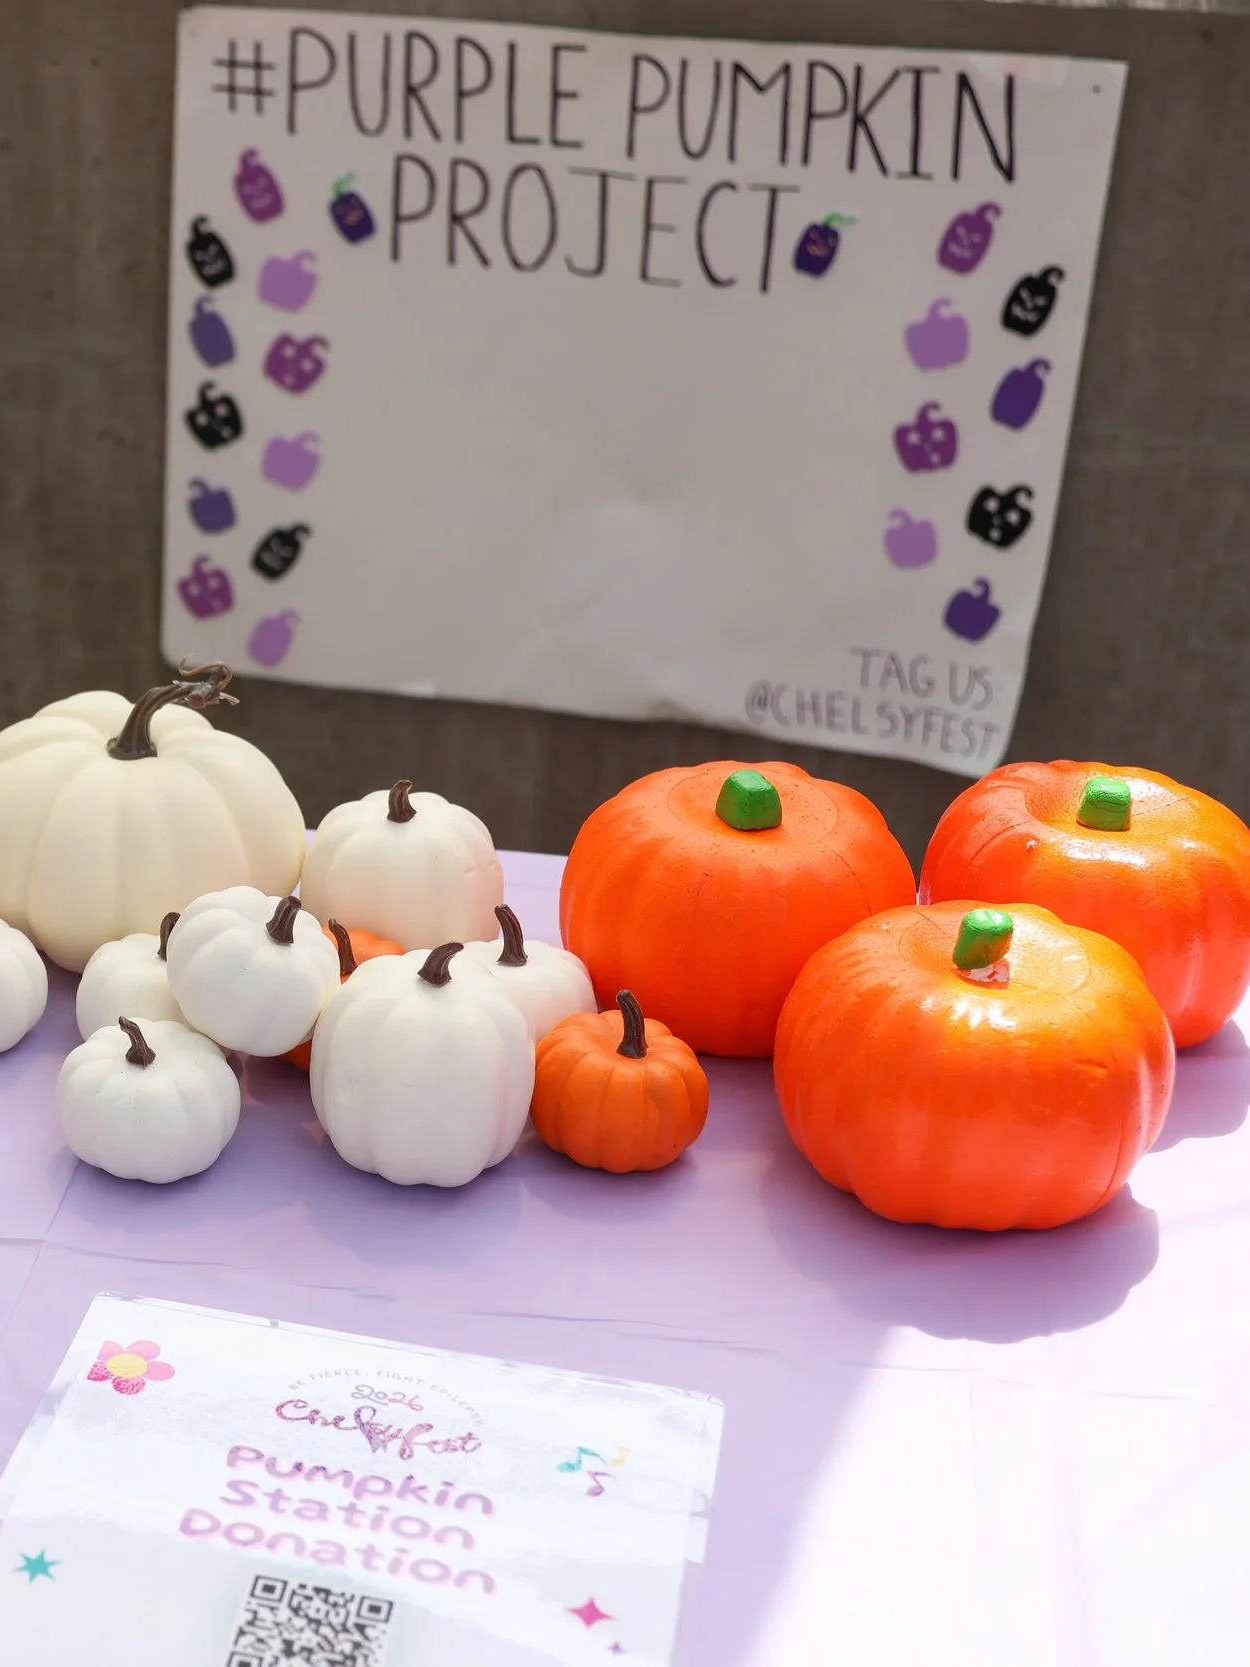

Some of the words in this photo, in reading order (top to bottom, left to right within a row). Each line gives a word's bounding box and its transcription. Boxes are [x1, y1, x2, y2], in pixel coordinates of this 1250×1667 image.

[212, 26, 588, 149] #PURPLE
[626, 53, 1017, 184] PUMPKIN
[390, 152, 800, 295] PROJECT
[848, 645, 937, 698] TAG
[948, 661, 997, 711] US
[745, 679, 1000, 760] @CHELSYFEST
[288, 1379, 306, 1391] BE
[377, 1370, 425, 1385] FIGHT
[350, 1384, 424, 1411] 2026
[220, 1479, 476, 1553] Station
[226, 1444, 495, 1518] Pumpkin
[179, 1508, 497, 1596] Donation
